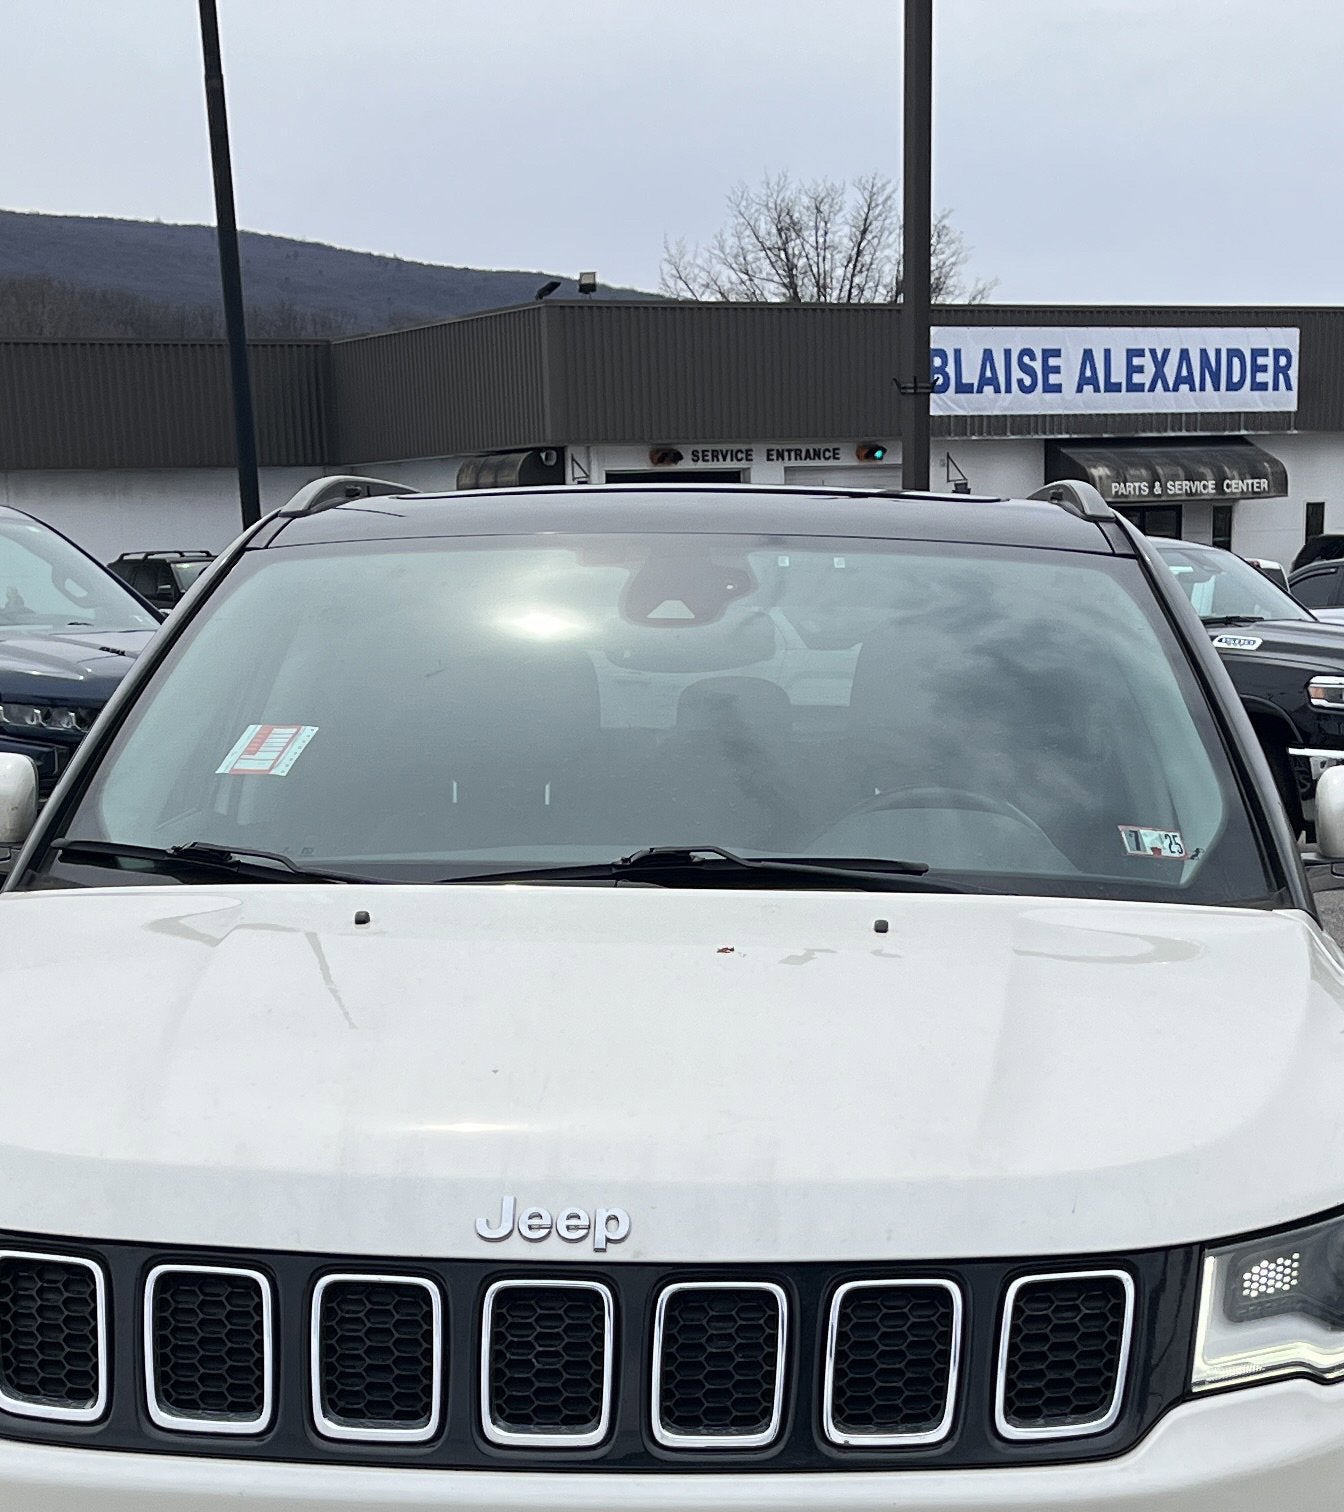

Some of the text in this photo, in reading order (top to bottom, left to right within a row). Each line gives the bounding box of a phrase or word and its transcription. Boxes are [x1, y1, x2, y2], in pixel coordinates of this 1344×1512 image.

[930, 347, 1294, 394] BLAISE ALEXANDER
[690, 447, 841, 463] SERVICE ENTRANCE
[1111, 478, 1269, 495] PARTS & SERVICE CENTER
[475, 1194, 631, 1253] Jeep
